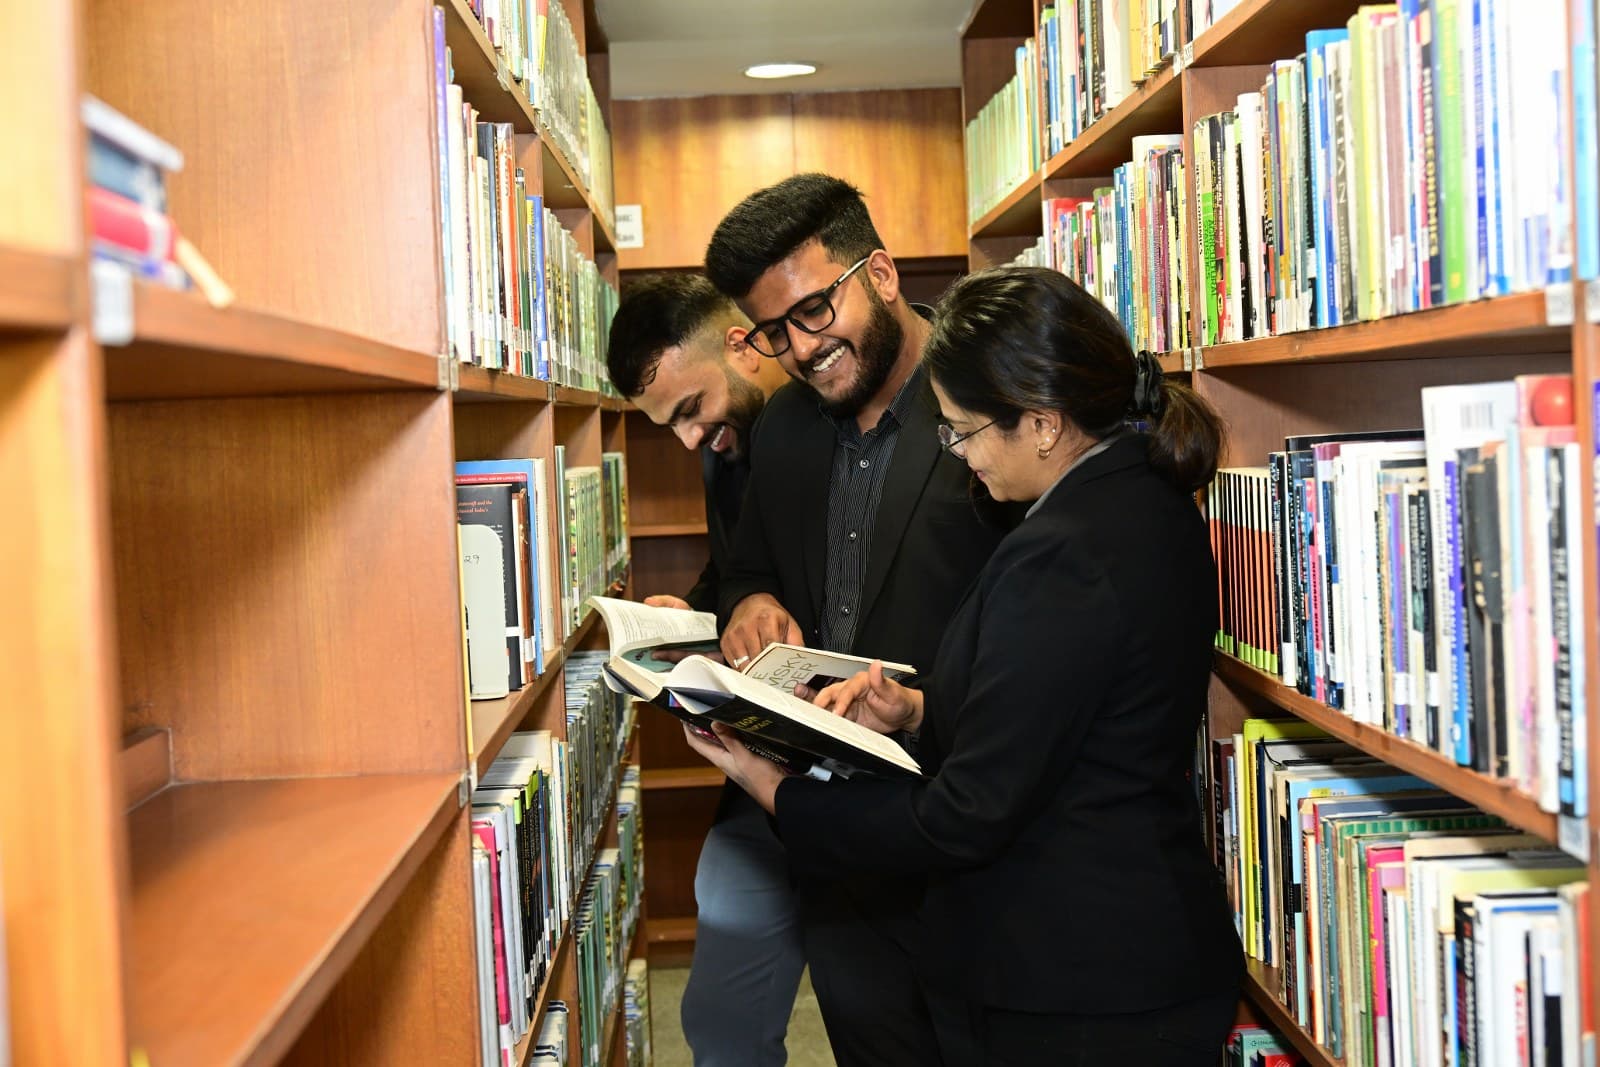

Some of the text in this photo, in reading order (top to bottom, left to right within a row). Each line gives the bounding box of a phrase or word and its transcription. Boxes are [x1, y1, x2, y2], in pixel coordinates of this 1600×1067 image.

[1421, 67, 1438, 256] MICROECONOMICS
[1207, 220, 1216, 296] AGRICULTURAL
[1463, 937, 1473, 977] BAD
